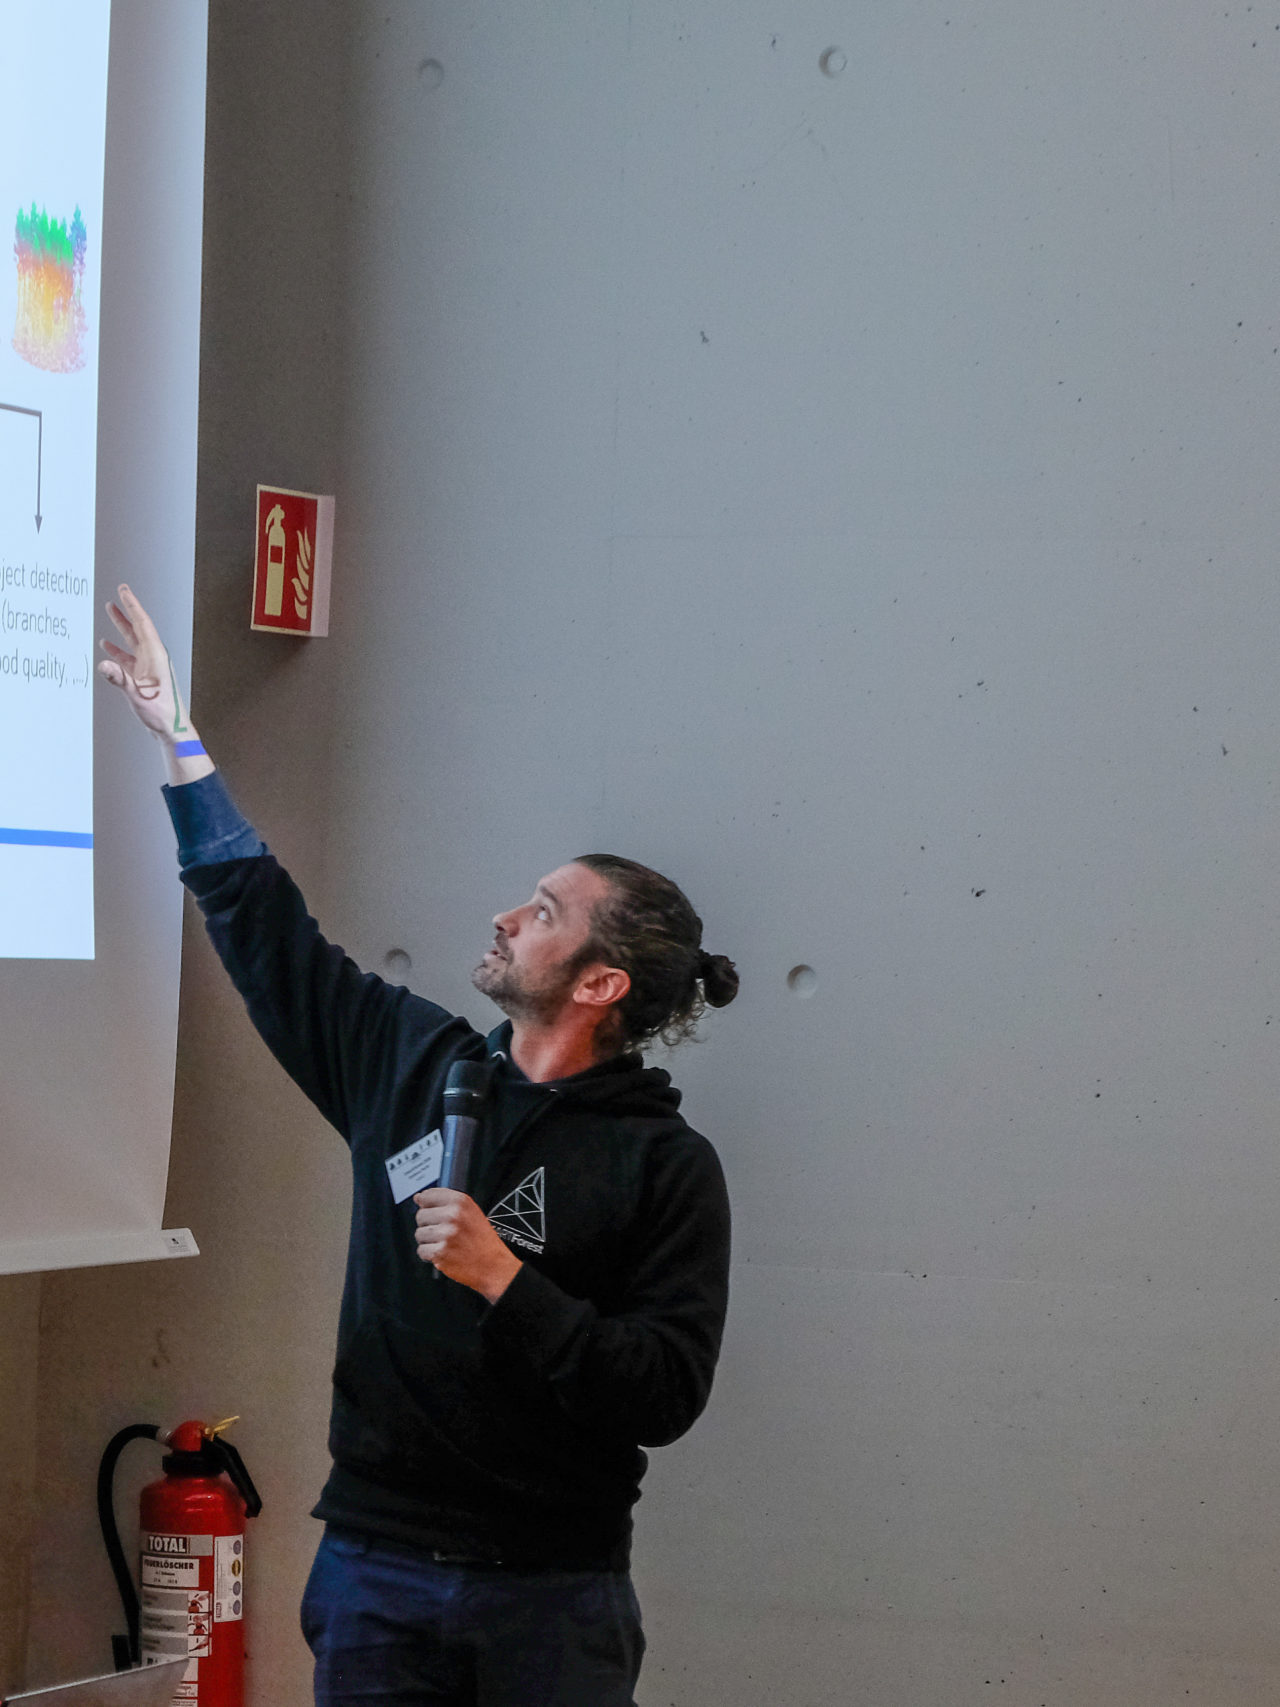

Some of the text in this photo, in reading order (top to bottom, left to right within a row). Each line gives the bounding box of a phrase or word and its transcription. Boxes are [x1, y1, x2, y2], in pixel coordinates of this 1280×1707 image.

[30, 562, 89, 597] detection
[1, 598, 71, 641] (branches,
[22, 651, 68, 689] quality,
[148, 1535, 187, 1553] TOTAL
